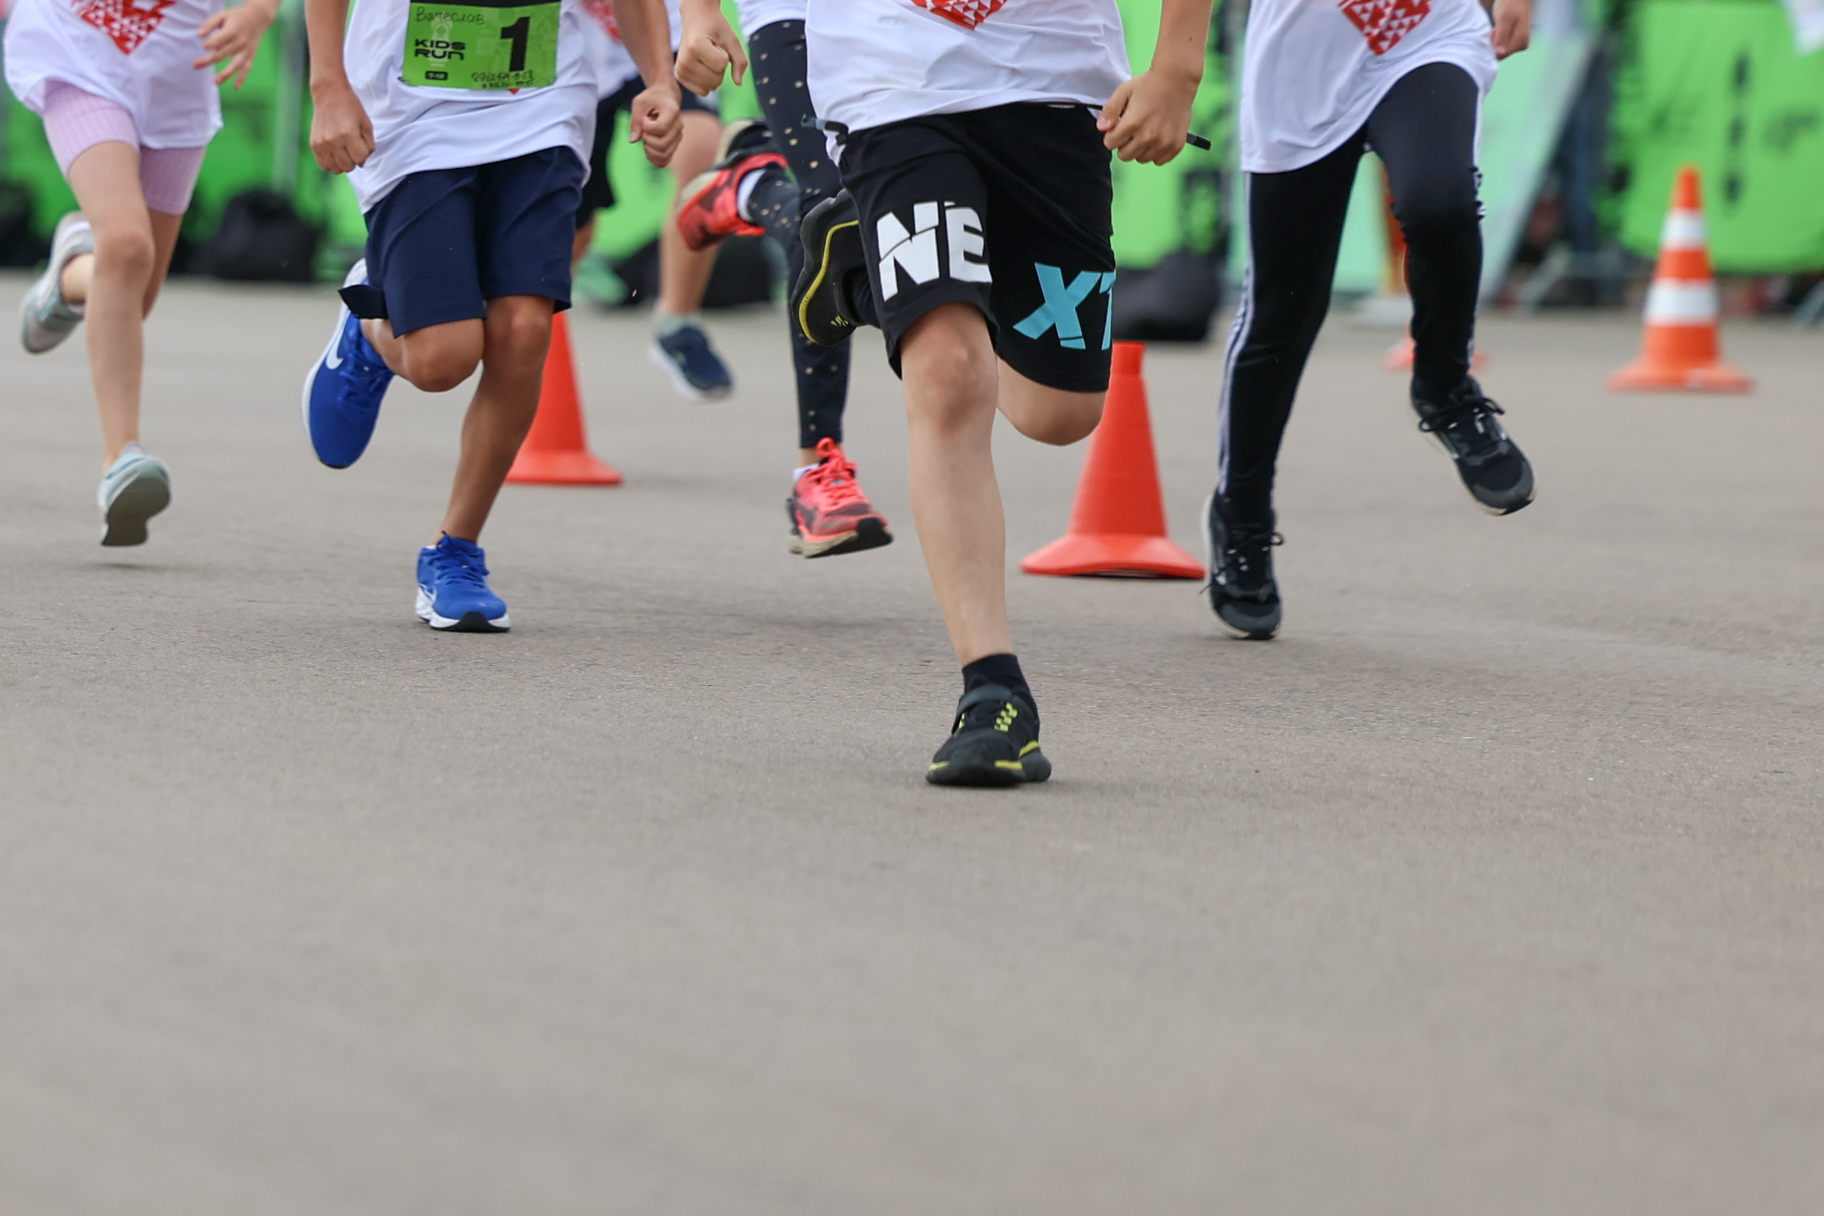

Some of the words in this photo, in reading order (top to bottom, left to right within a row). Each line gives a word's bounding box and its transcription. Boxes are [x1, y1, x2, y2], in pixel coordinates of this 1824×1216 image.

[415, 39, 466, 50] KIDS
[500, 16, 531, 72] 1
[877, 201, 993, 302] NE
